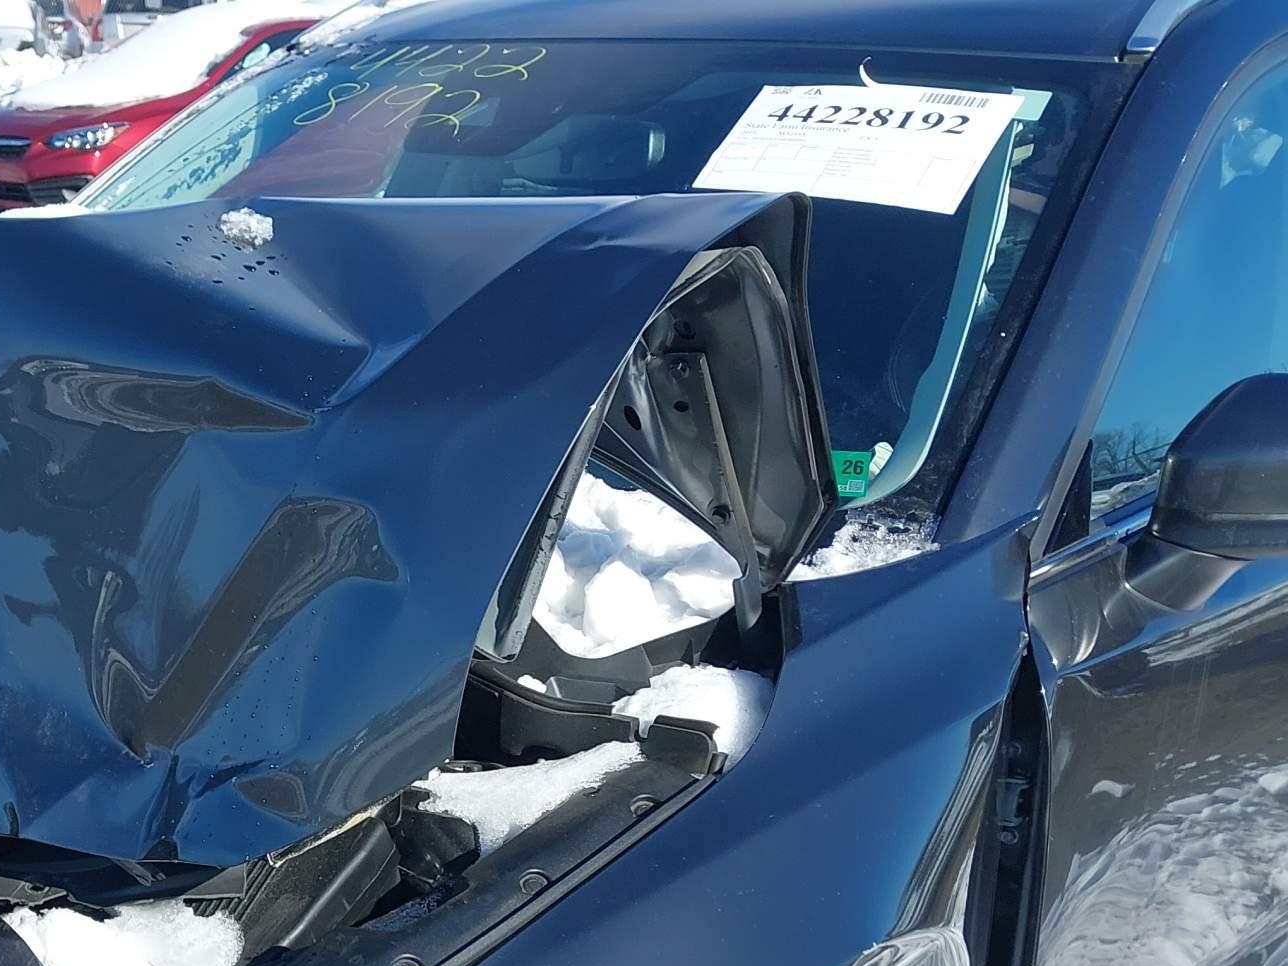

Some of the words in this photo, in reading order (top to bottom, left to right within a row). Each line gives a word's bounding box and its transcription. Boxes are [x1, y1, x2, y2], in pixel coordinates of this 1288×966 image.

[349, 44, 547, 80] 4422
[293, 82, 481, 136] 8192
[768, 103, 970, 135] 44228192
[842, 460, 864, 475] 26
